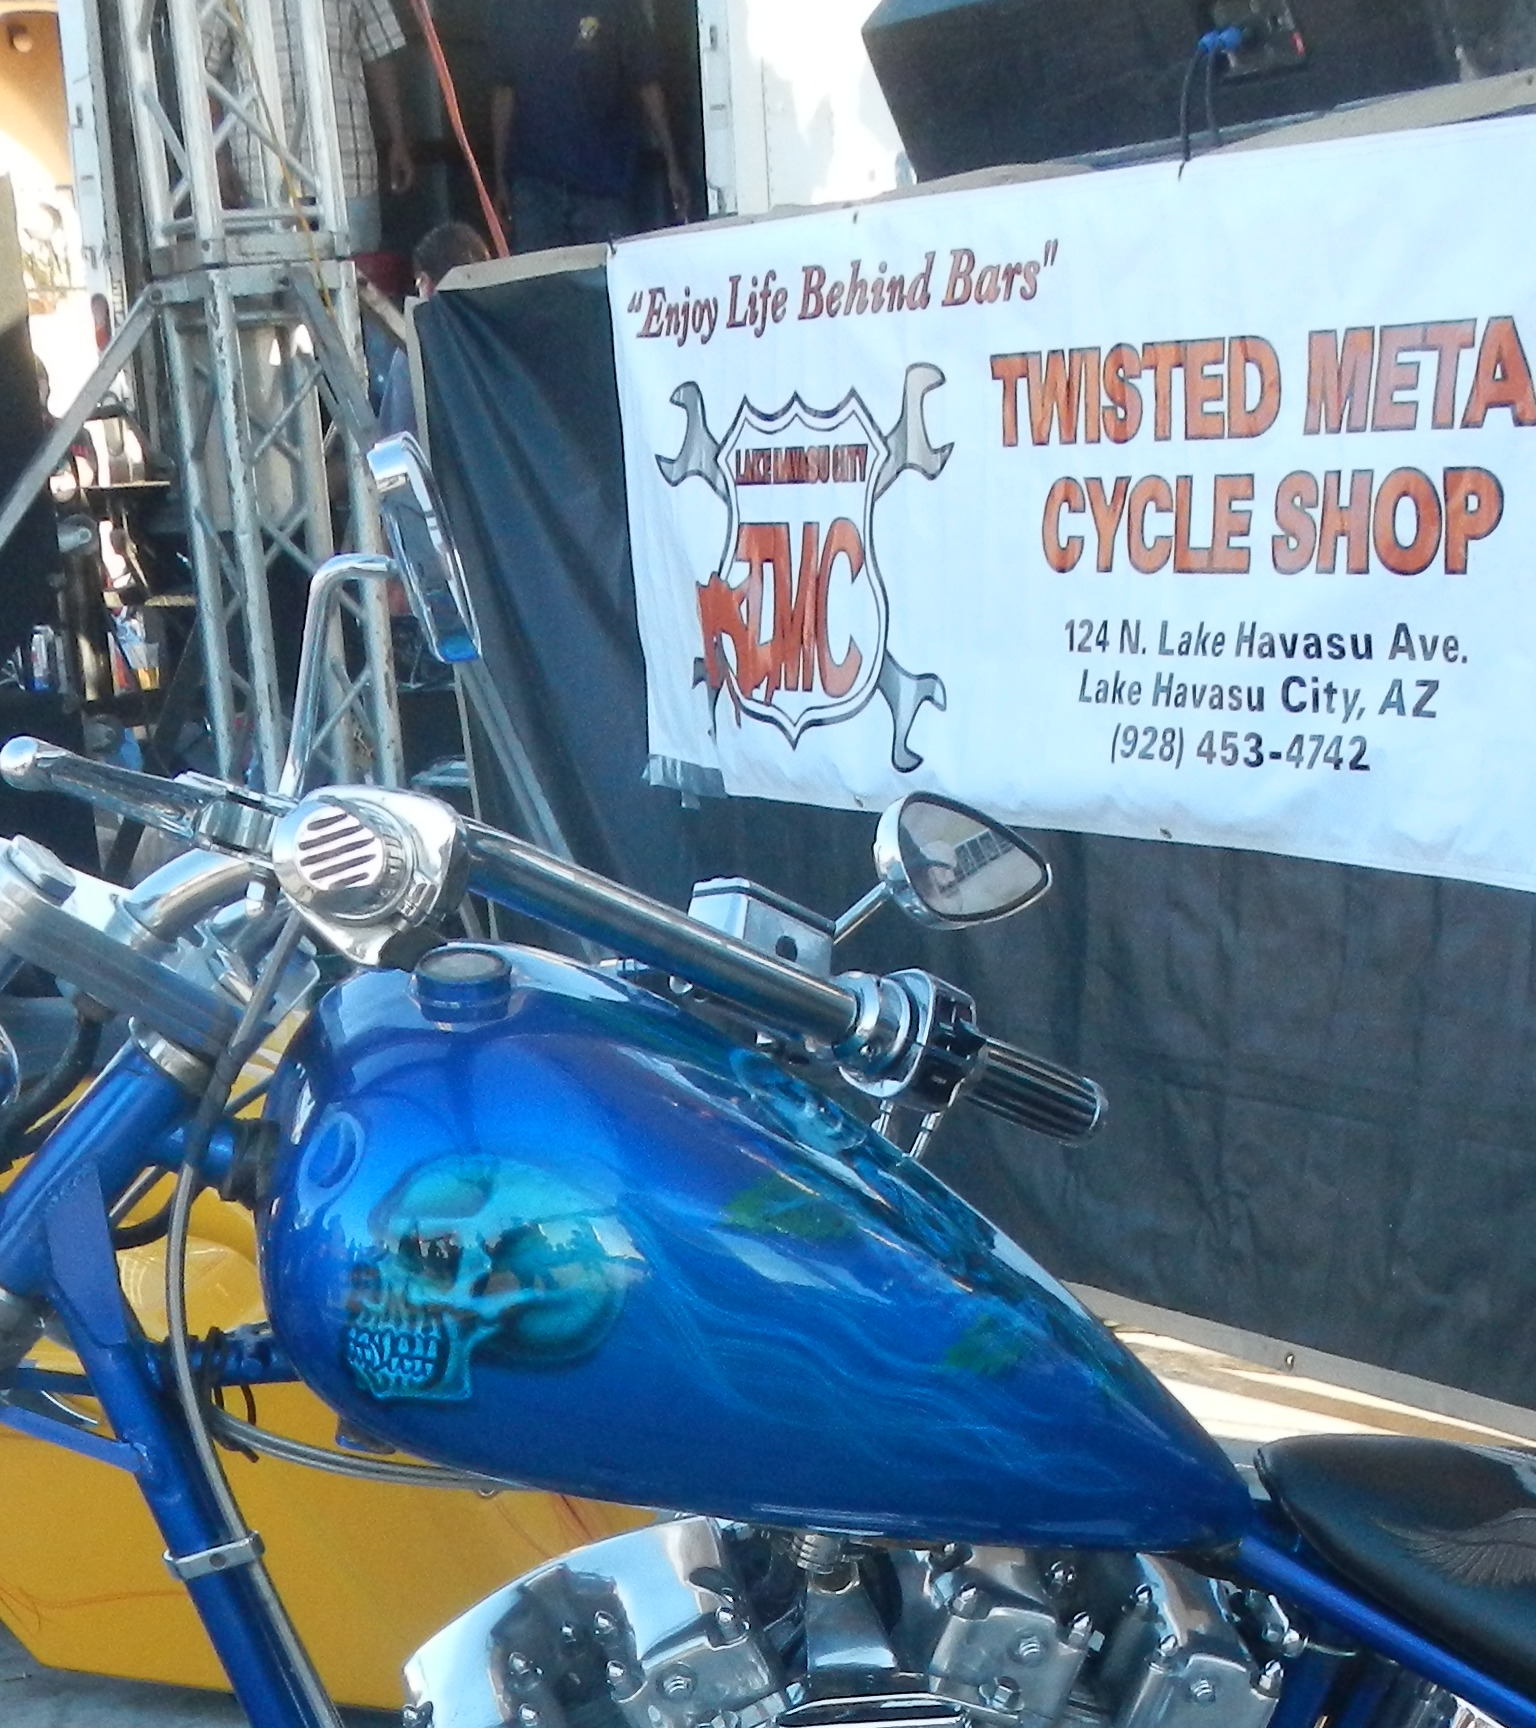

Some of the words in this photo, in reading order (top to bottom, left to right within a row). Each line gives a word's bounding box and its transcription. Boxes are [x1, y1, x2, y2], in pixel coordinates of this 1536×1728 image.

[726, 270, 787, 338] Life
[797, 250, 936, 320] Behind
[990, 335, 1282, 448] TWISTED
[735, 447, 772, 486] LAKE
[832, 443, 869, 483] CITY
[1041, 472, 1255, 575] CYCLE
[1271, 466, 1505, 576] SHOP
[1064, 618, 1110, 654] 124
[1119, 619, 1147, 655] N.
[1157, 620, 1225, 658] Lake
[1234, 621, 1374, 661] Havasu
[1387, 622, 1469, 664] Ave.
[1078, 669, 1142, 707] Lake
[1151, 671, 1265, 712] Havasu
[1281, 675, 1366, 724] City,
[1377, 678, 1441, 719] AZ
[1110, 722, 1185, 770] (928)
[1196, 730, 1371, 772] 453-4742
